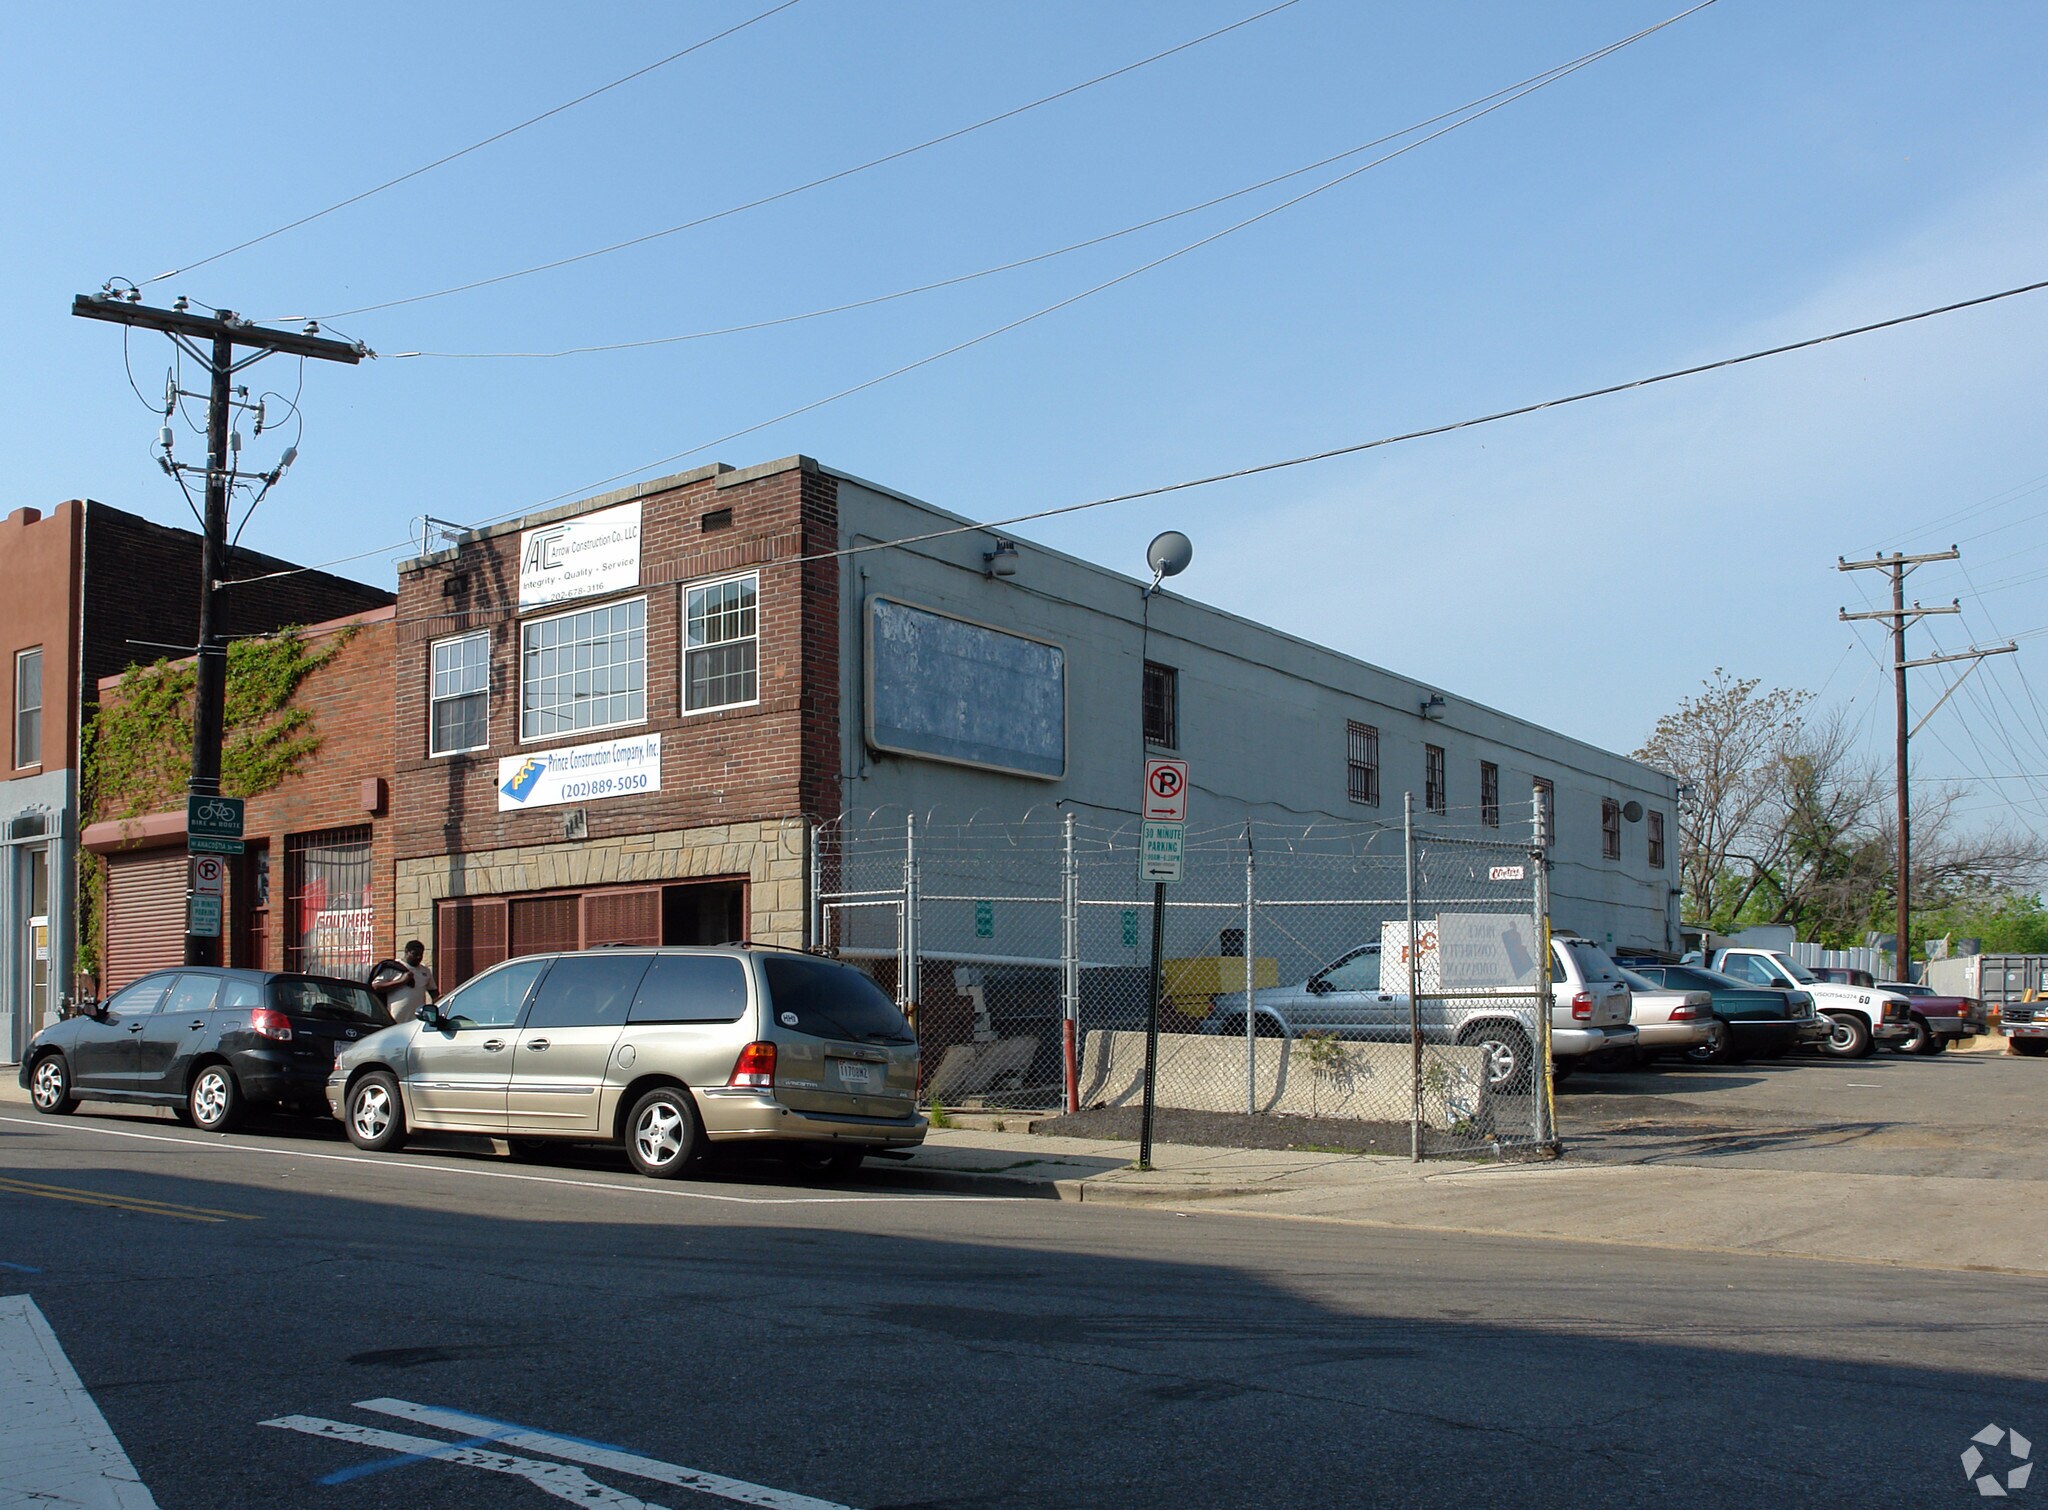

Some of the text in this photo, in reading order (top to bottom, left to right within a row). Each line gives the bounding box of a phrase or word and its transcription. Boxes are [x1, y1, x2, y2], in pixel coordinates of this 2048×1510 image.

[551, 545, 570, 558] Arrow
[571, 533, 611, 554] Construction
[624, 525, 638, 540] LLC
[523, 558, 634, 590] Integrity Quality Service
[548, 738, 659, 773] Prince Construction Company, Inc.
[561, 773, 648, 801] (202)889-5050
[1145, 828, 1182, 840] 30 MINUTE
[1147, 841, 1178, 852] PARKING
[1858, 995, 1871, 1005] 60
